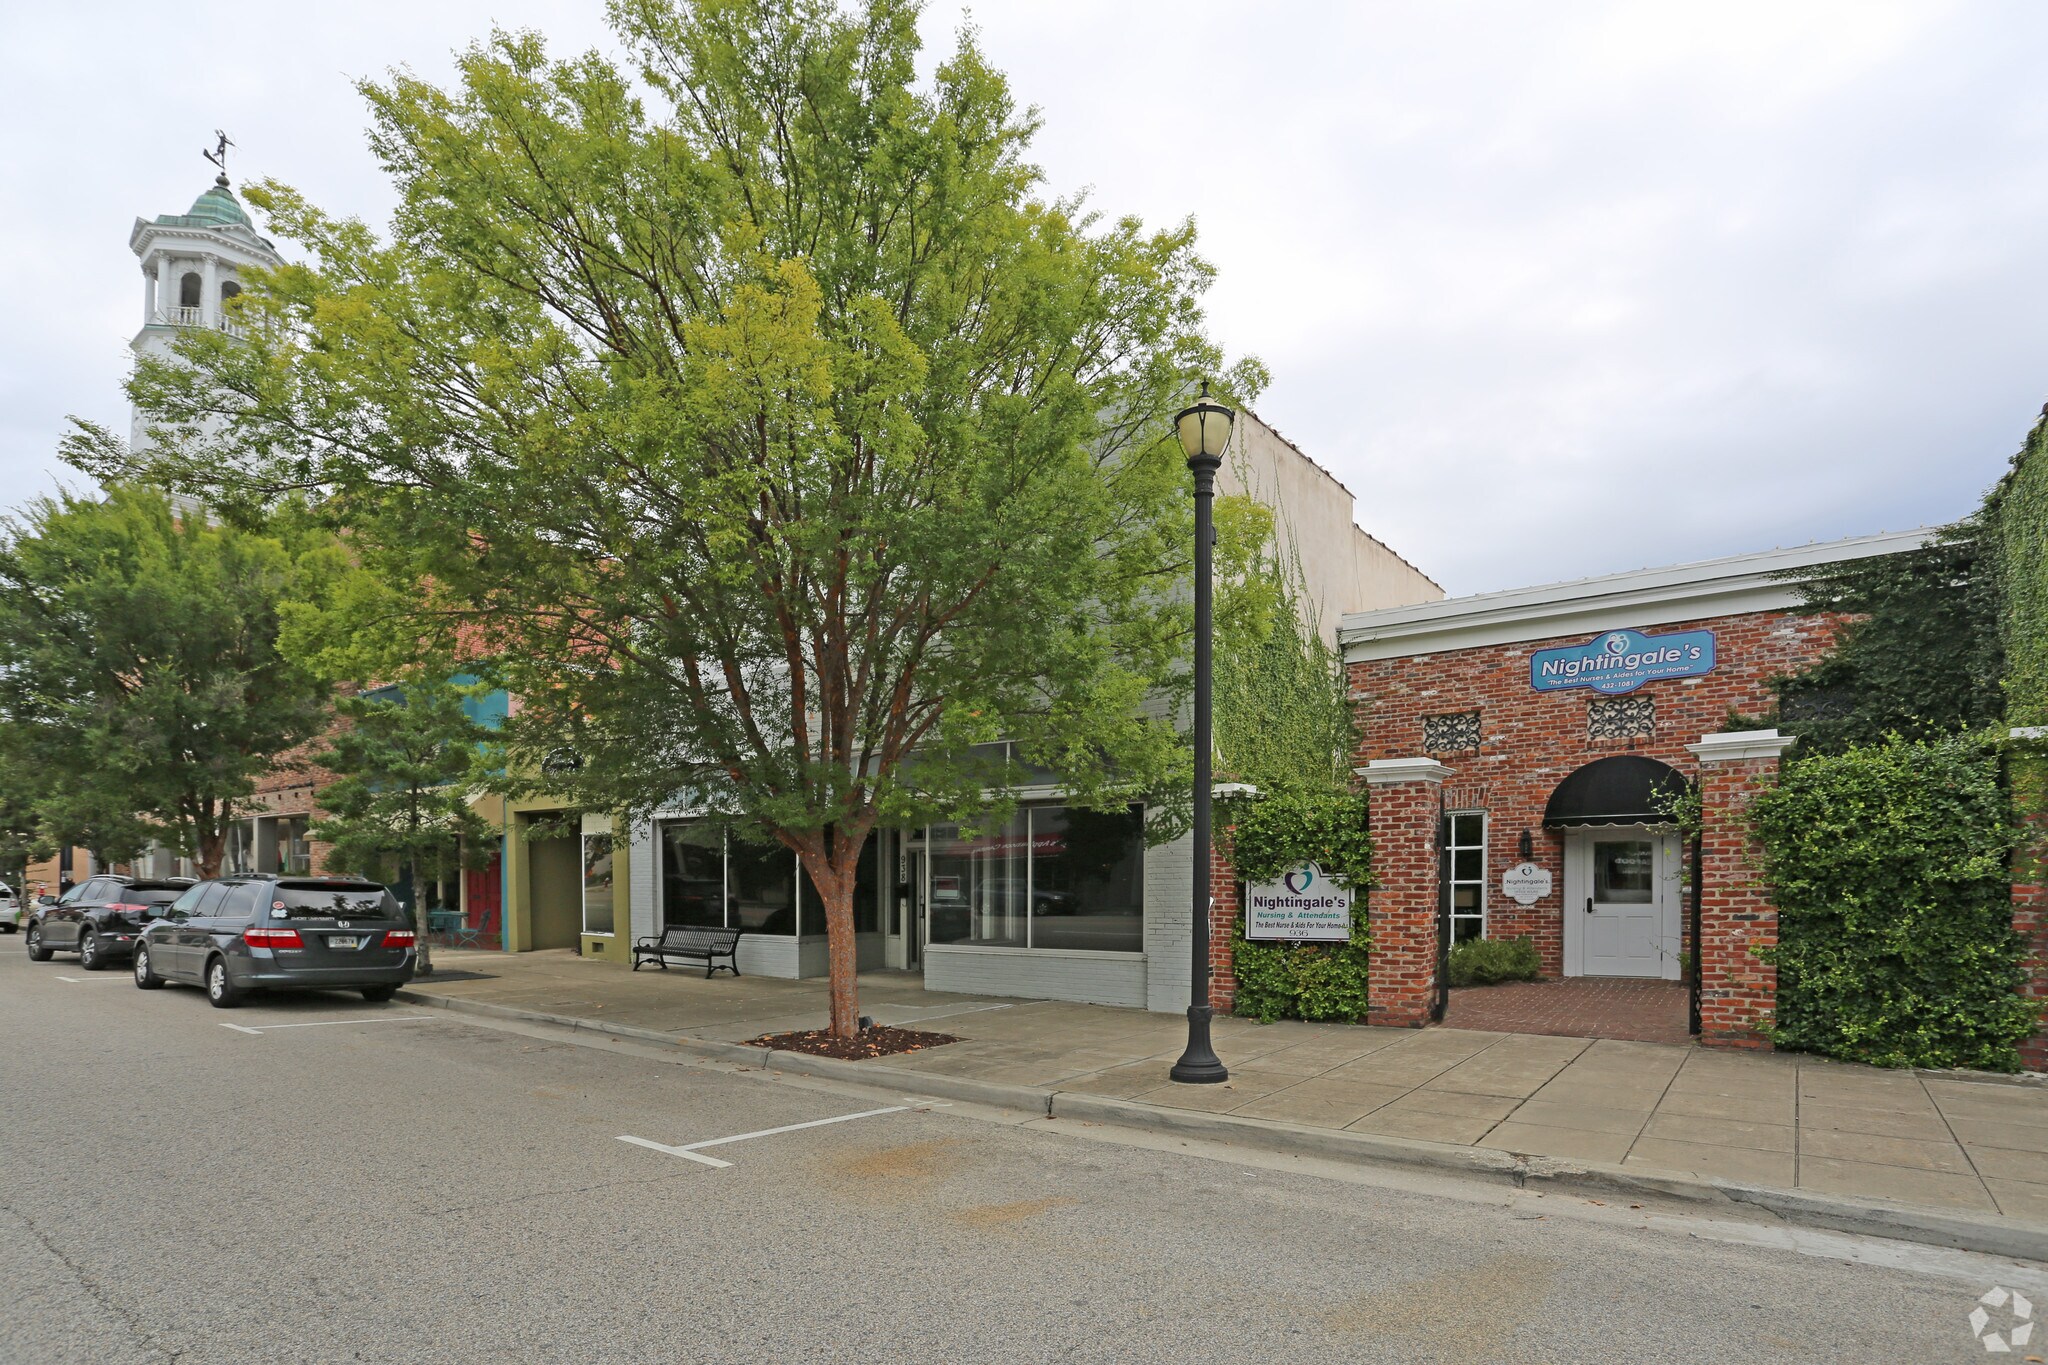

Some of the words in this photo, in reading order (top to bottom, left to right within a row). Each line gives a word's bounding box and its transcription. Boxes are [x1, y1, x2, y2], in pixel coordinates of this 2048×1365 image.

[1541, 644, 1701, 677] Nightingale's
[1601, 681, 1634, 689] 432-1081
[1253, 896, 1346, 910] Nightingale's
[1257, 911, 1286, 920] Nursing
[1287, 911, 1293, 919] &
[1297, 911, 1341, 919] Attendants
[1289, 929, 1309, 937] 936
